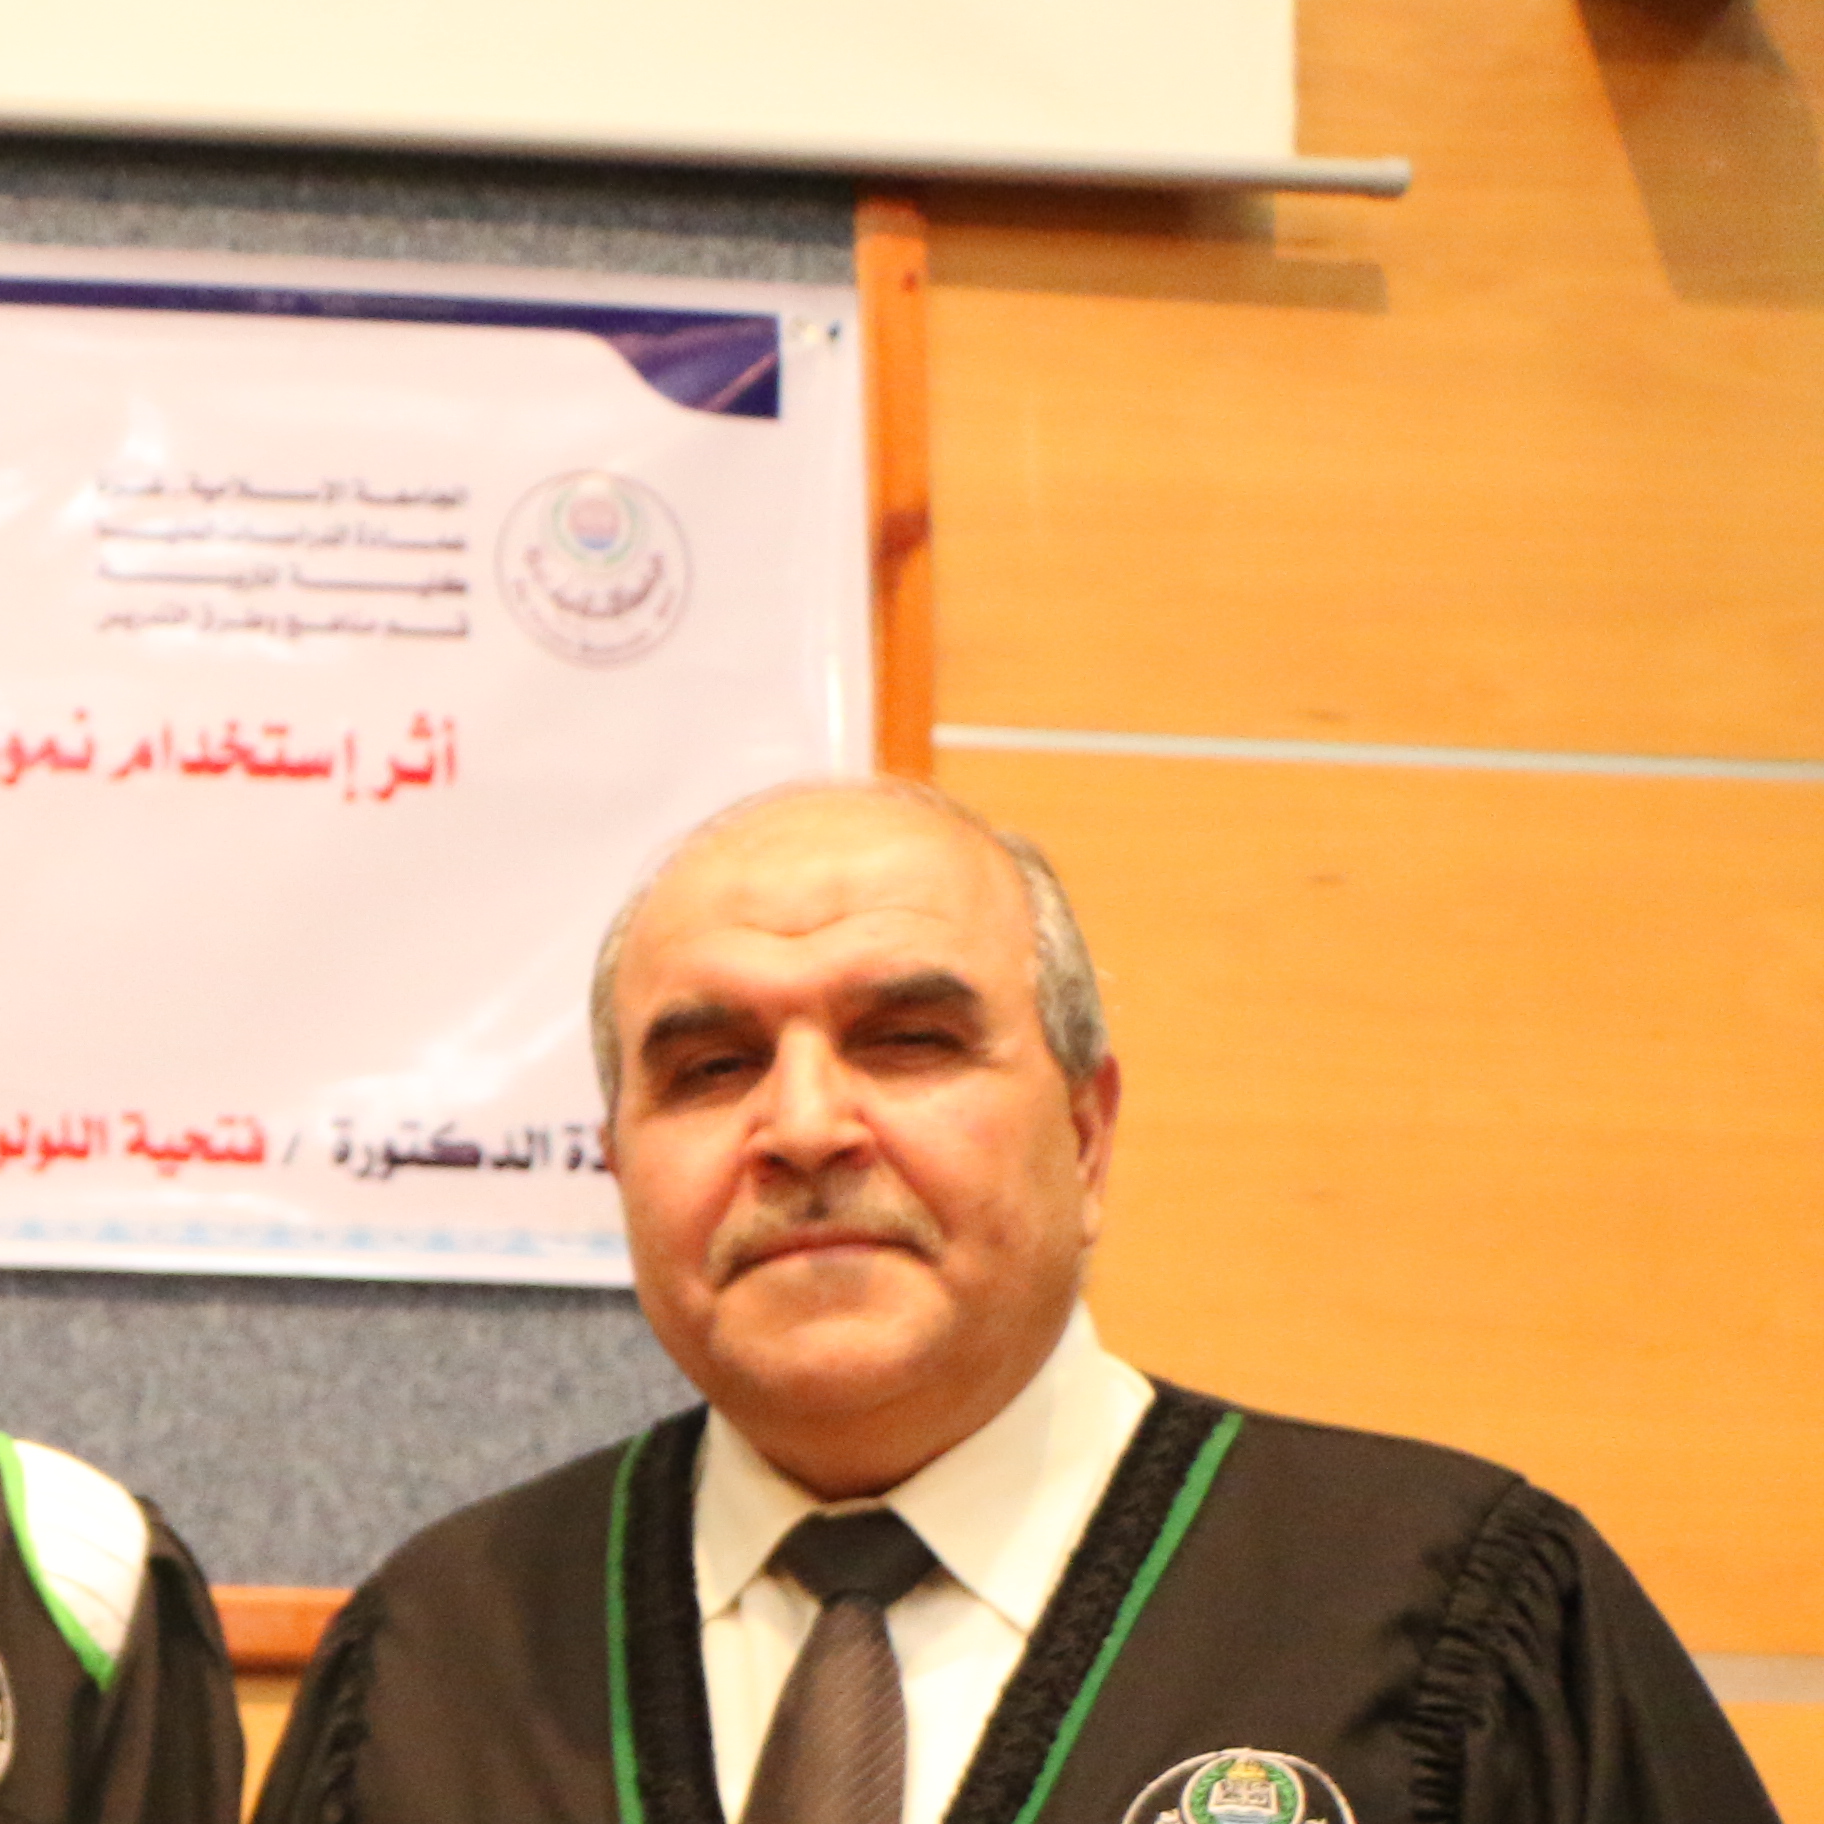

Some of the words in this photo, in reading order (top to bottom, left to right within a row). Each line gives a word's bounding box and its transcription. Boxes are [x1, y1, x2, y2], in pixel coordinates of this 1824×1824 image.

[110, 722, 357, 803] إستخدام
[370, 714, 457, 804] أثر
[122, 1112, 267, 1178] فتحية
[332, 1117, 551, 1181] الدكتورة
